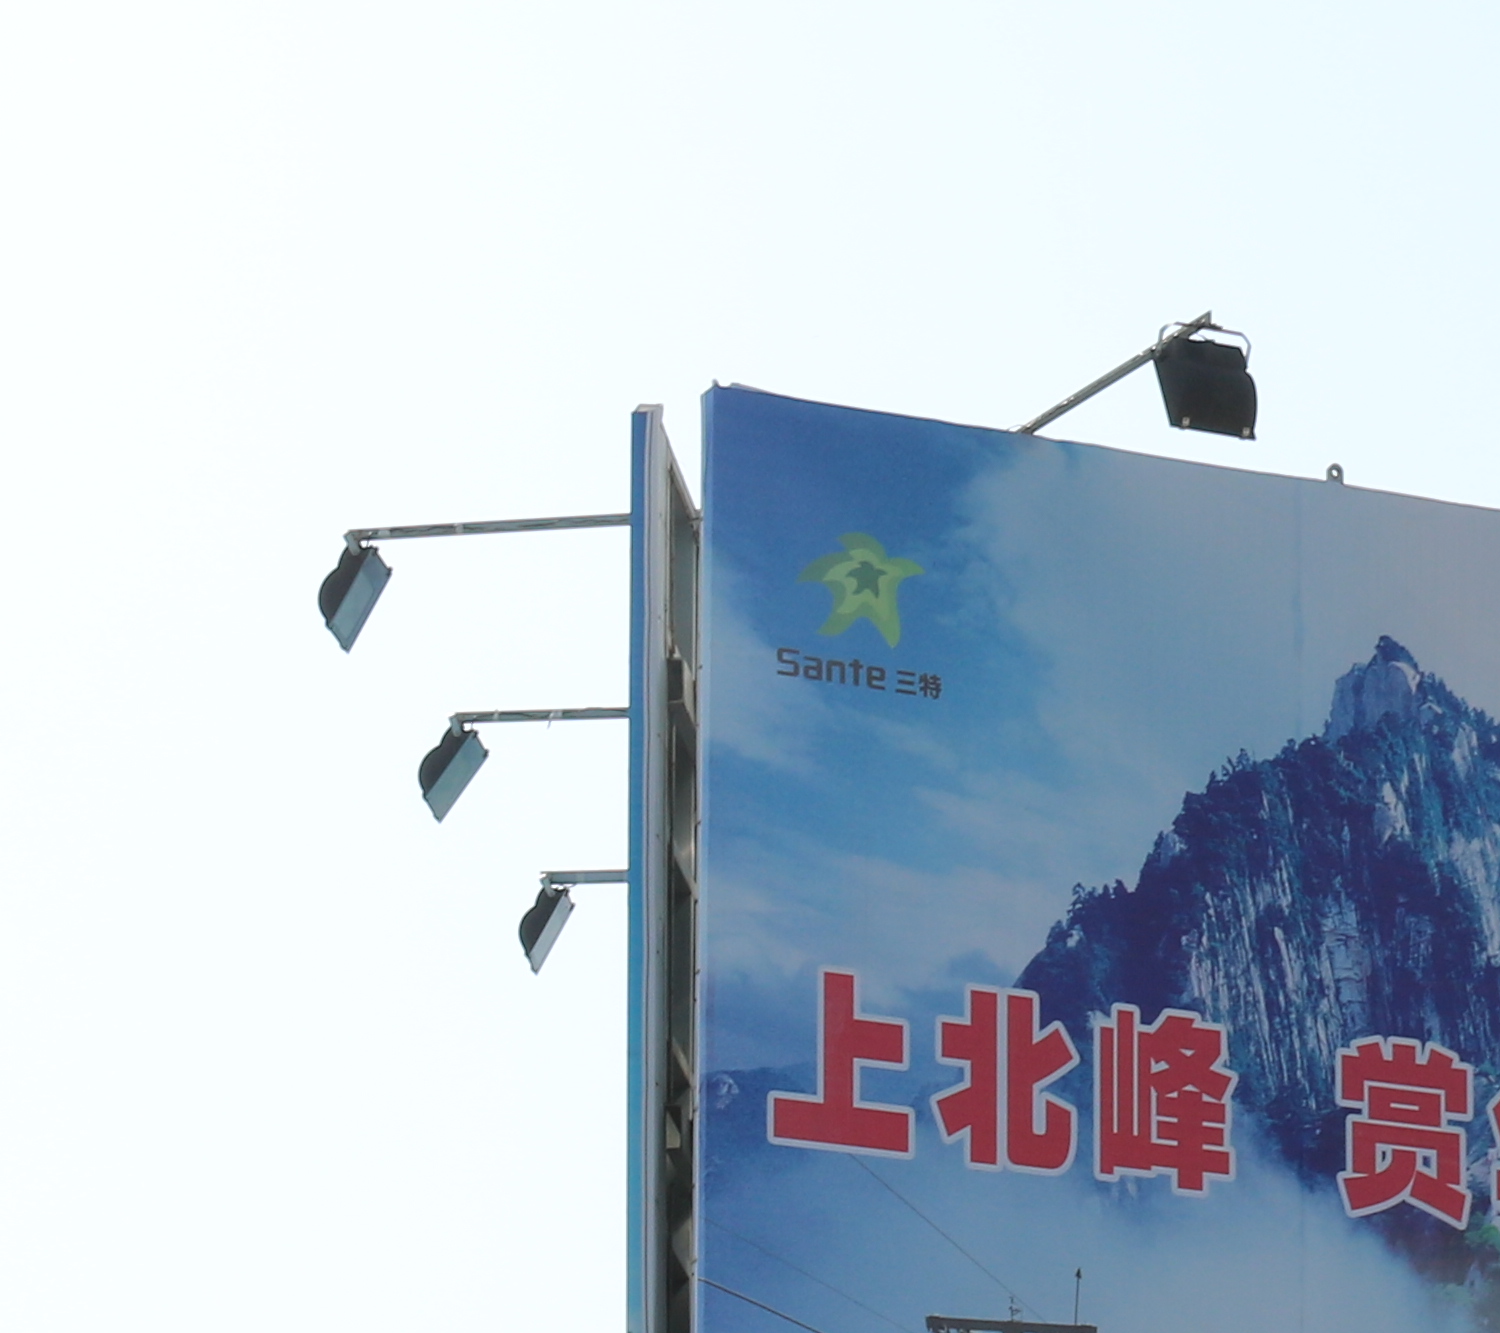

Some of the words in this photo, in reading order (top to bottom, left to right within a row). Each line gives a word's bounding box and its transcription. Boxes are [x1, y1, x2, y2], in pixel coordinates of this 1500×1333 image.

[776, 647, 886, 691] Sante
[895, 669, 942, 699] 三特
[767, 968, 1234, 1196] 上北峰
